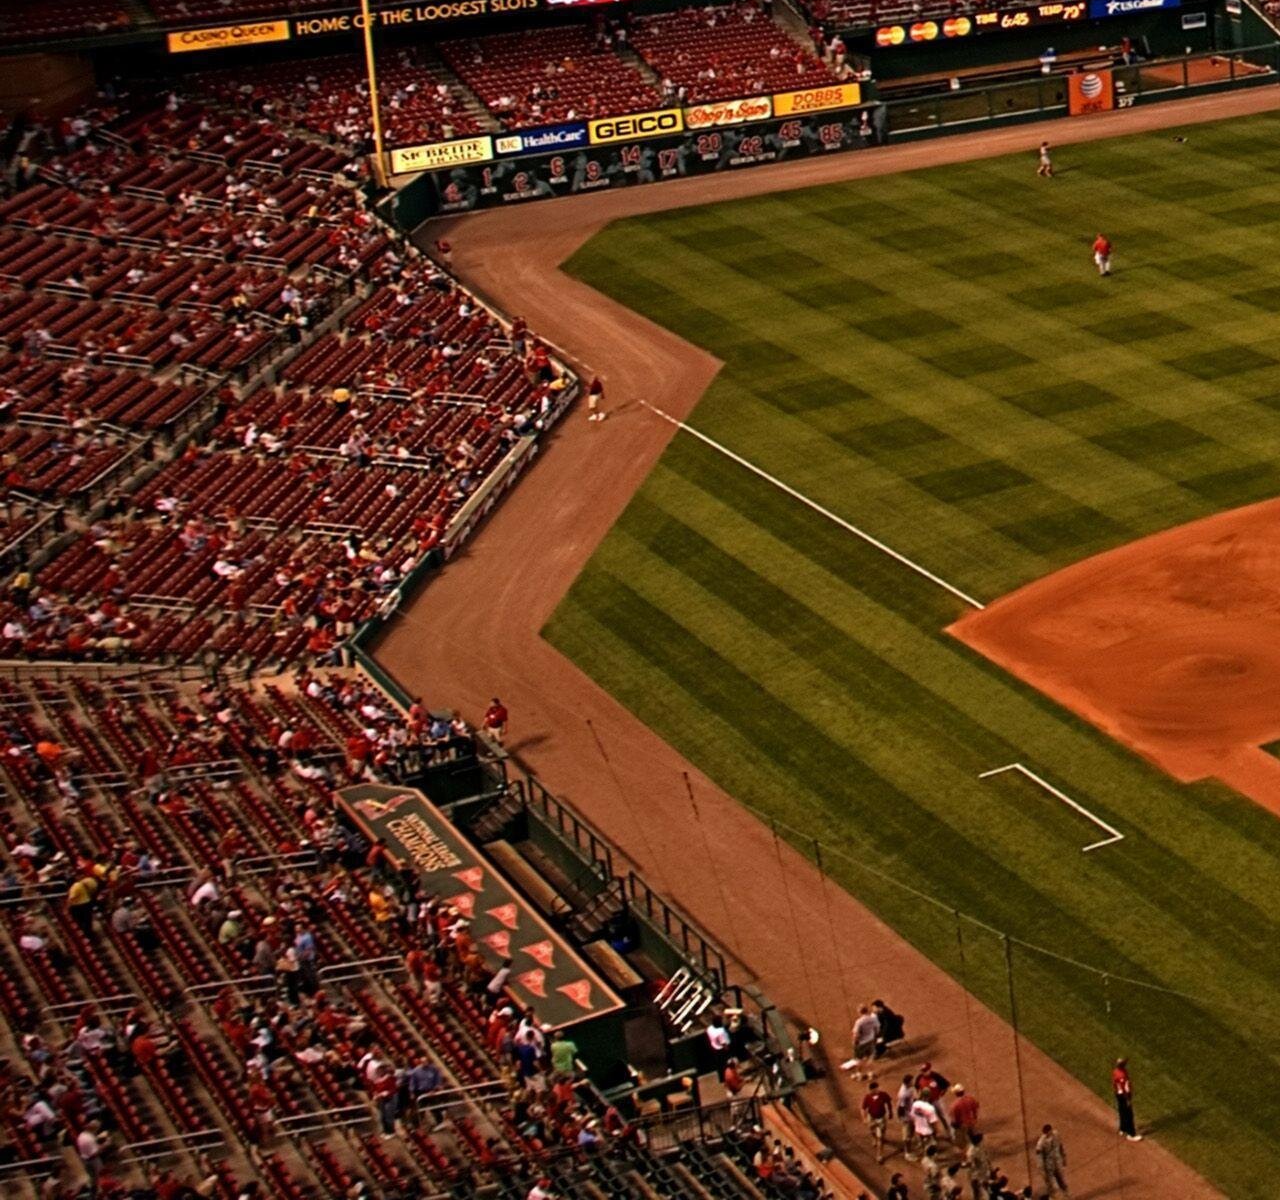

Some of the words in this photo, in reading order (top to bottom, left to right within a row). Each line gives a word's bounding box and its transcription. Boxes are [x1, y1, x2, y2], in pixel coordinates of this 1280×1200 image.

[296, 16, 350, 35] HOME
[380, 7, 413, 25] THE
[416, 0, 487, 21] LOOSEST
[976, 13, 998, 24] TIME
[1039, 4, 1063, 16] TEMP
[180, 30, 227, 43] CASINO
[230, 24, 275, 38] QUEEN
[793, 88, 844, 105] DOBBS
[596, 114, 677, 139] GEICO
[779, 121, 801, 140] 45
[820, 123, 844, 142] 85
[697, 134, 722, 154] 20
[738, 136, 763, 155] 42
[621, 145, 640, 166] 14
[658, 149, 678, 170] 17
[550, 156, 565, 177] 6
[586, 160, 600, 180] 9
[482, 167, 493, 187] 1
[513, 172, 529, 192] 2
[386, 820, 441, 872] CHAMPIONS
